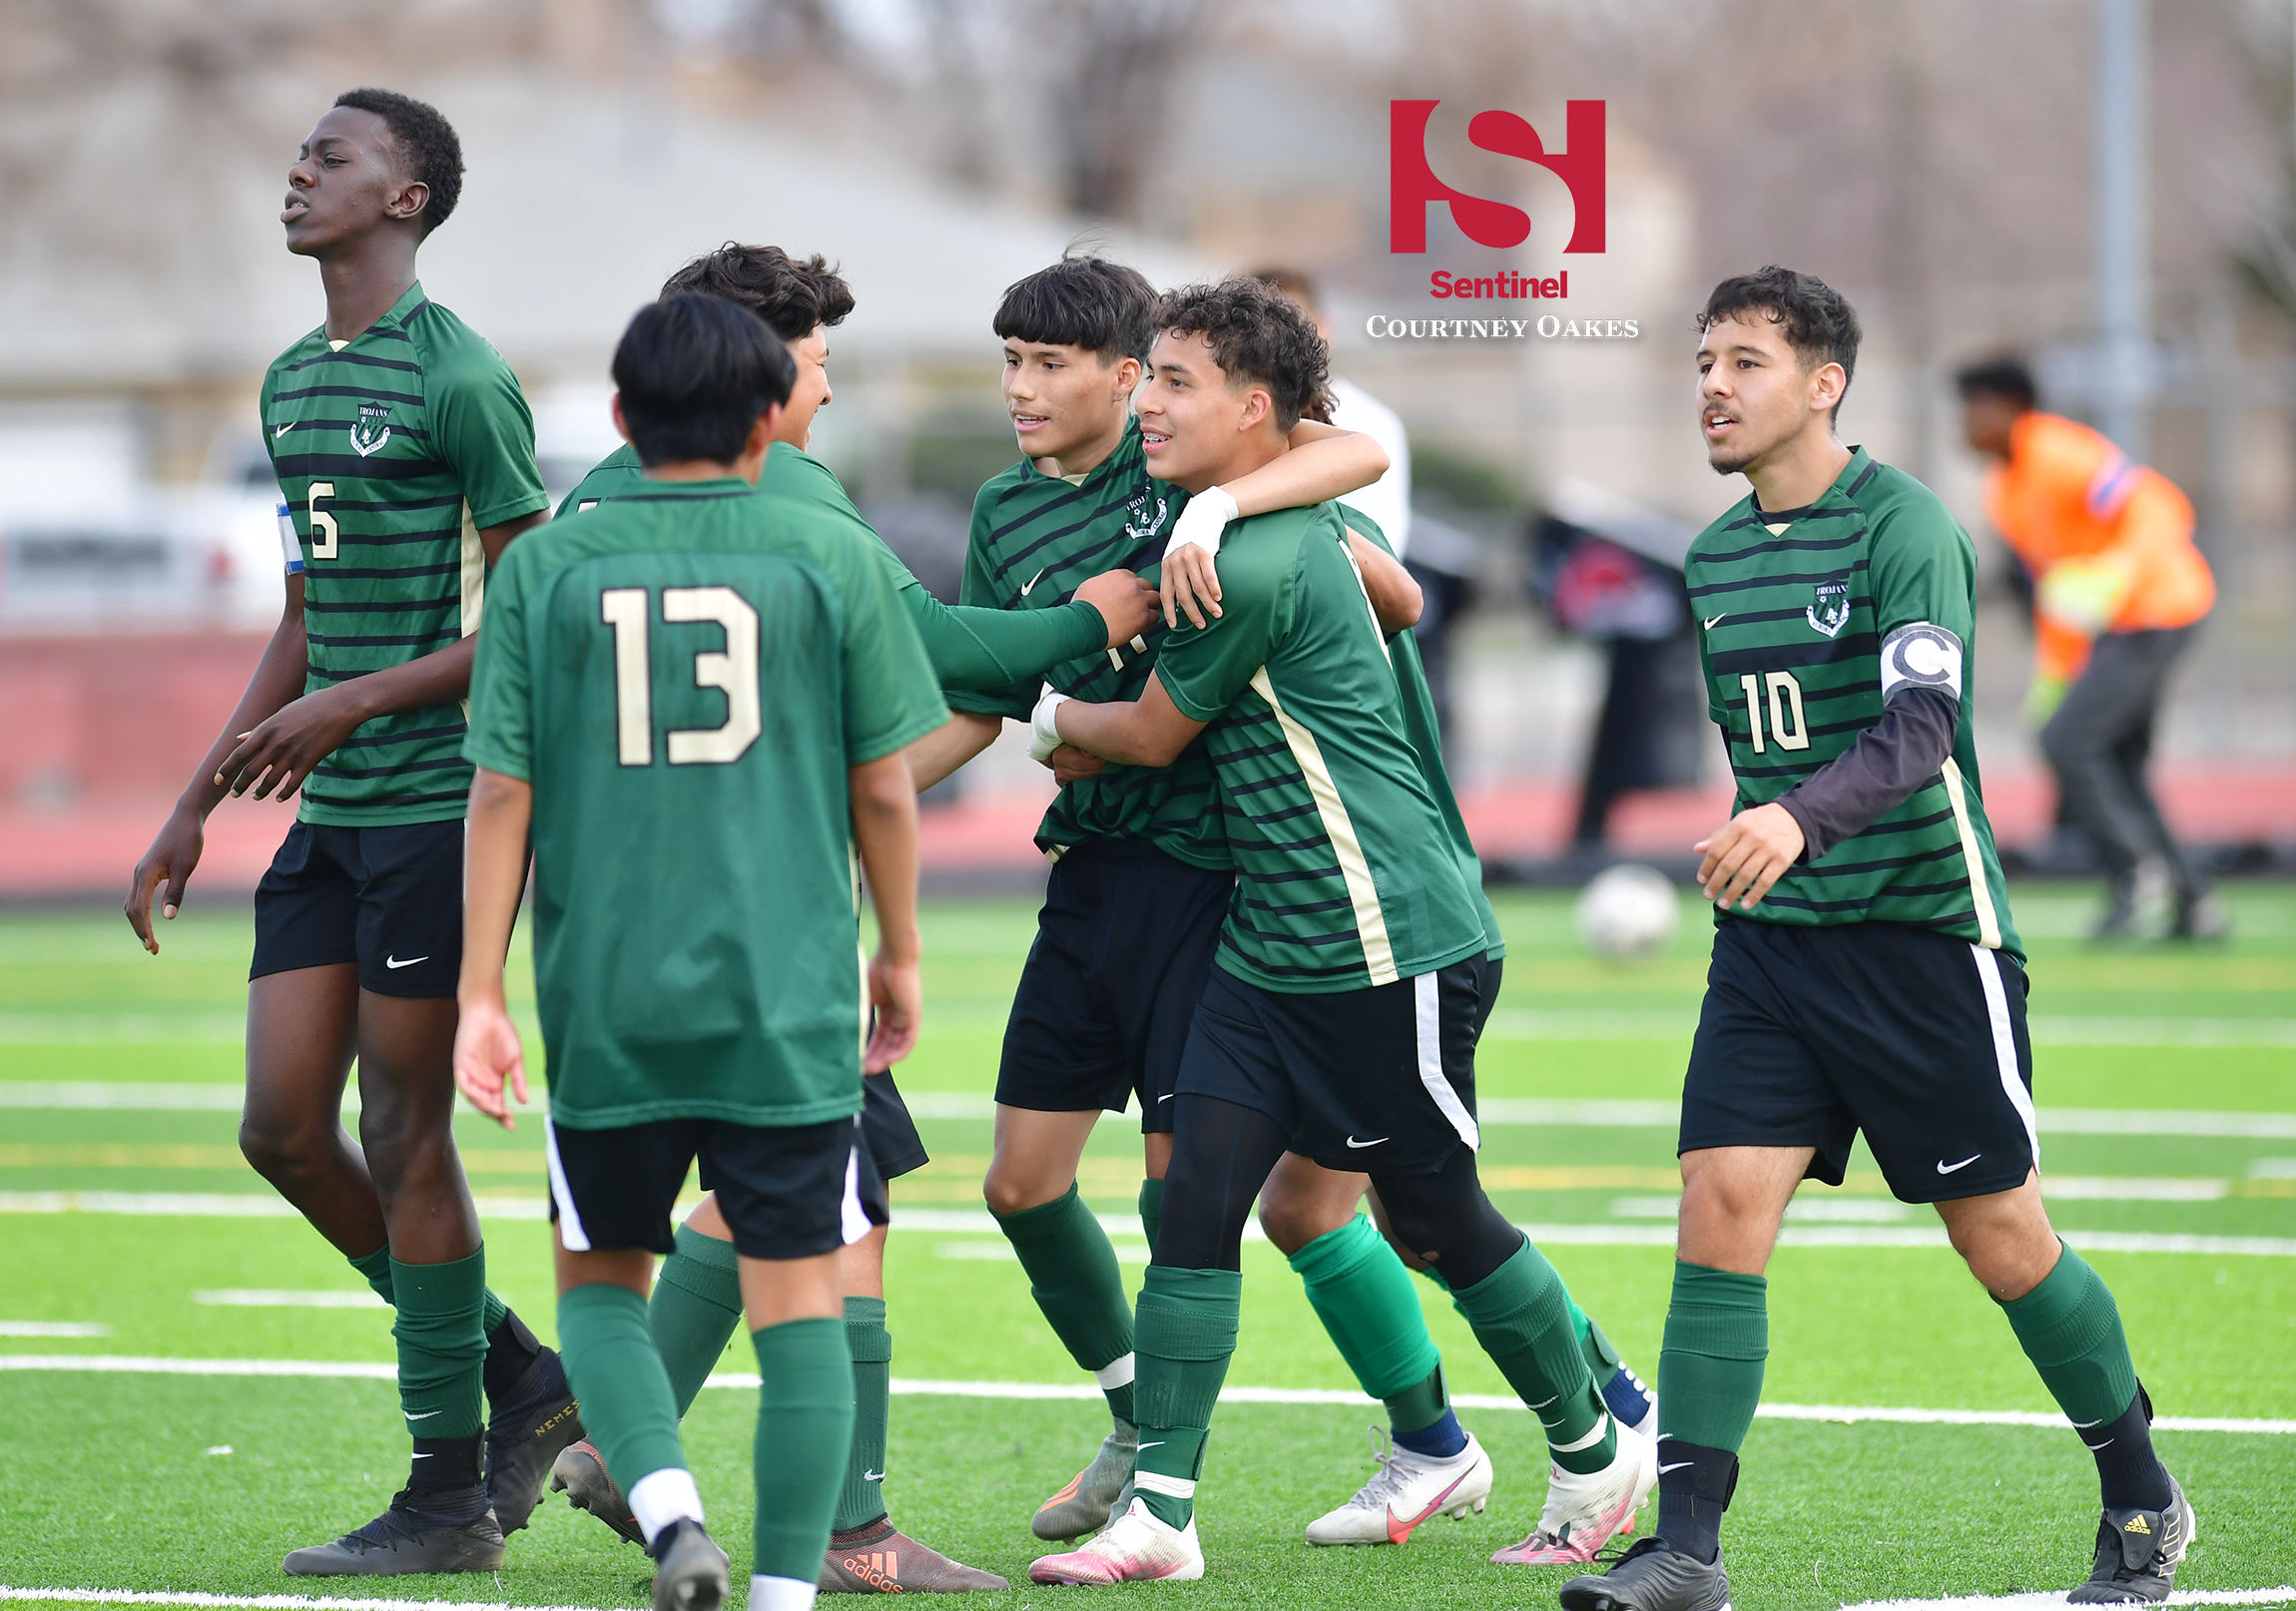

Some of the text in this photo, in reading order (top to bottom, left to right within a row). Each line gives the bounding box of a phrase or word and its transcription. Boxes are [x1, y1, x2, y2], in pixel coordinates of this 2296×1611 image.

[359, 406, 388, 417] TROJANS
[307, 481, 338, 560] 6
[601, 585, 763, 767] 13
[1893, 630, 1952, 685] C
[1740, 670, 1811, 755] 10
[2123, 1524, 2151, 1535] adidas
[843, 1557, 903, 1595] adidas
